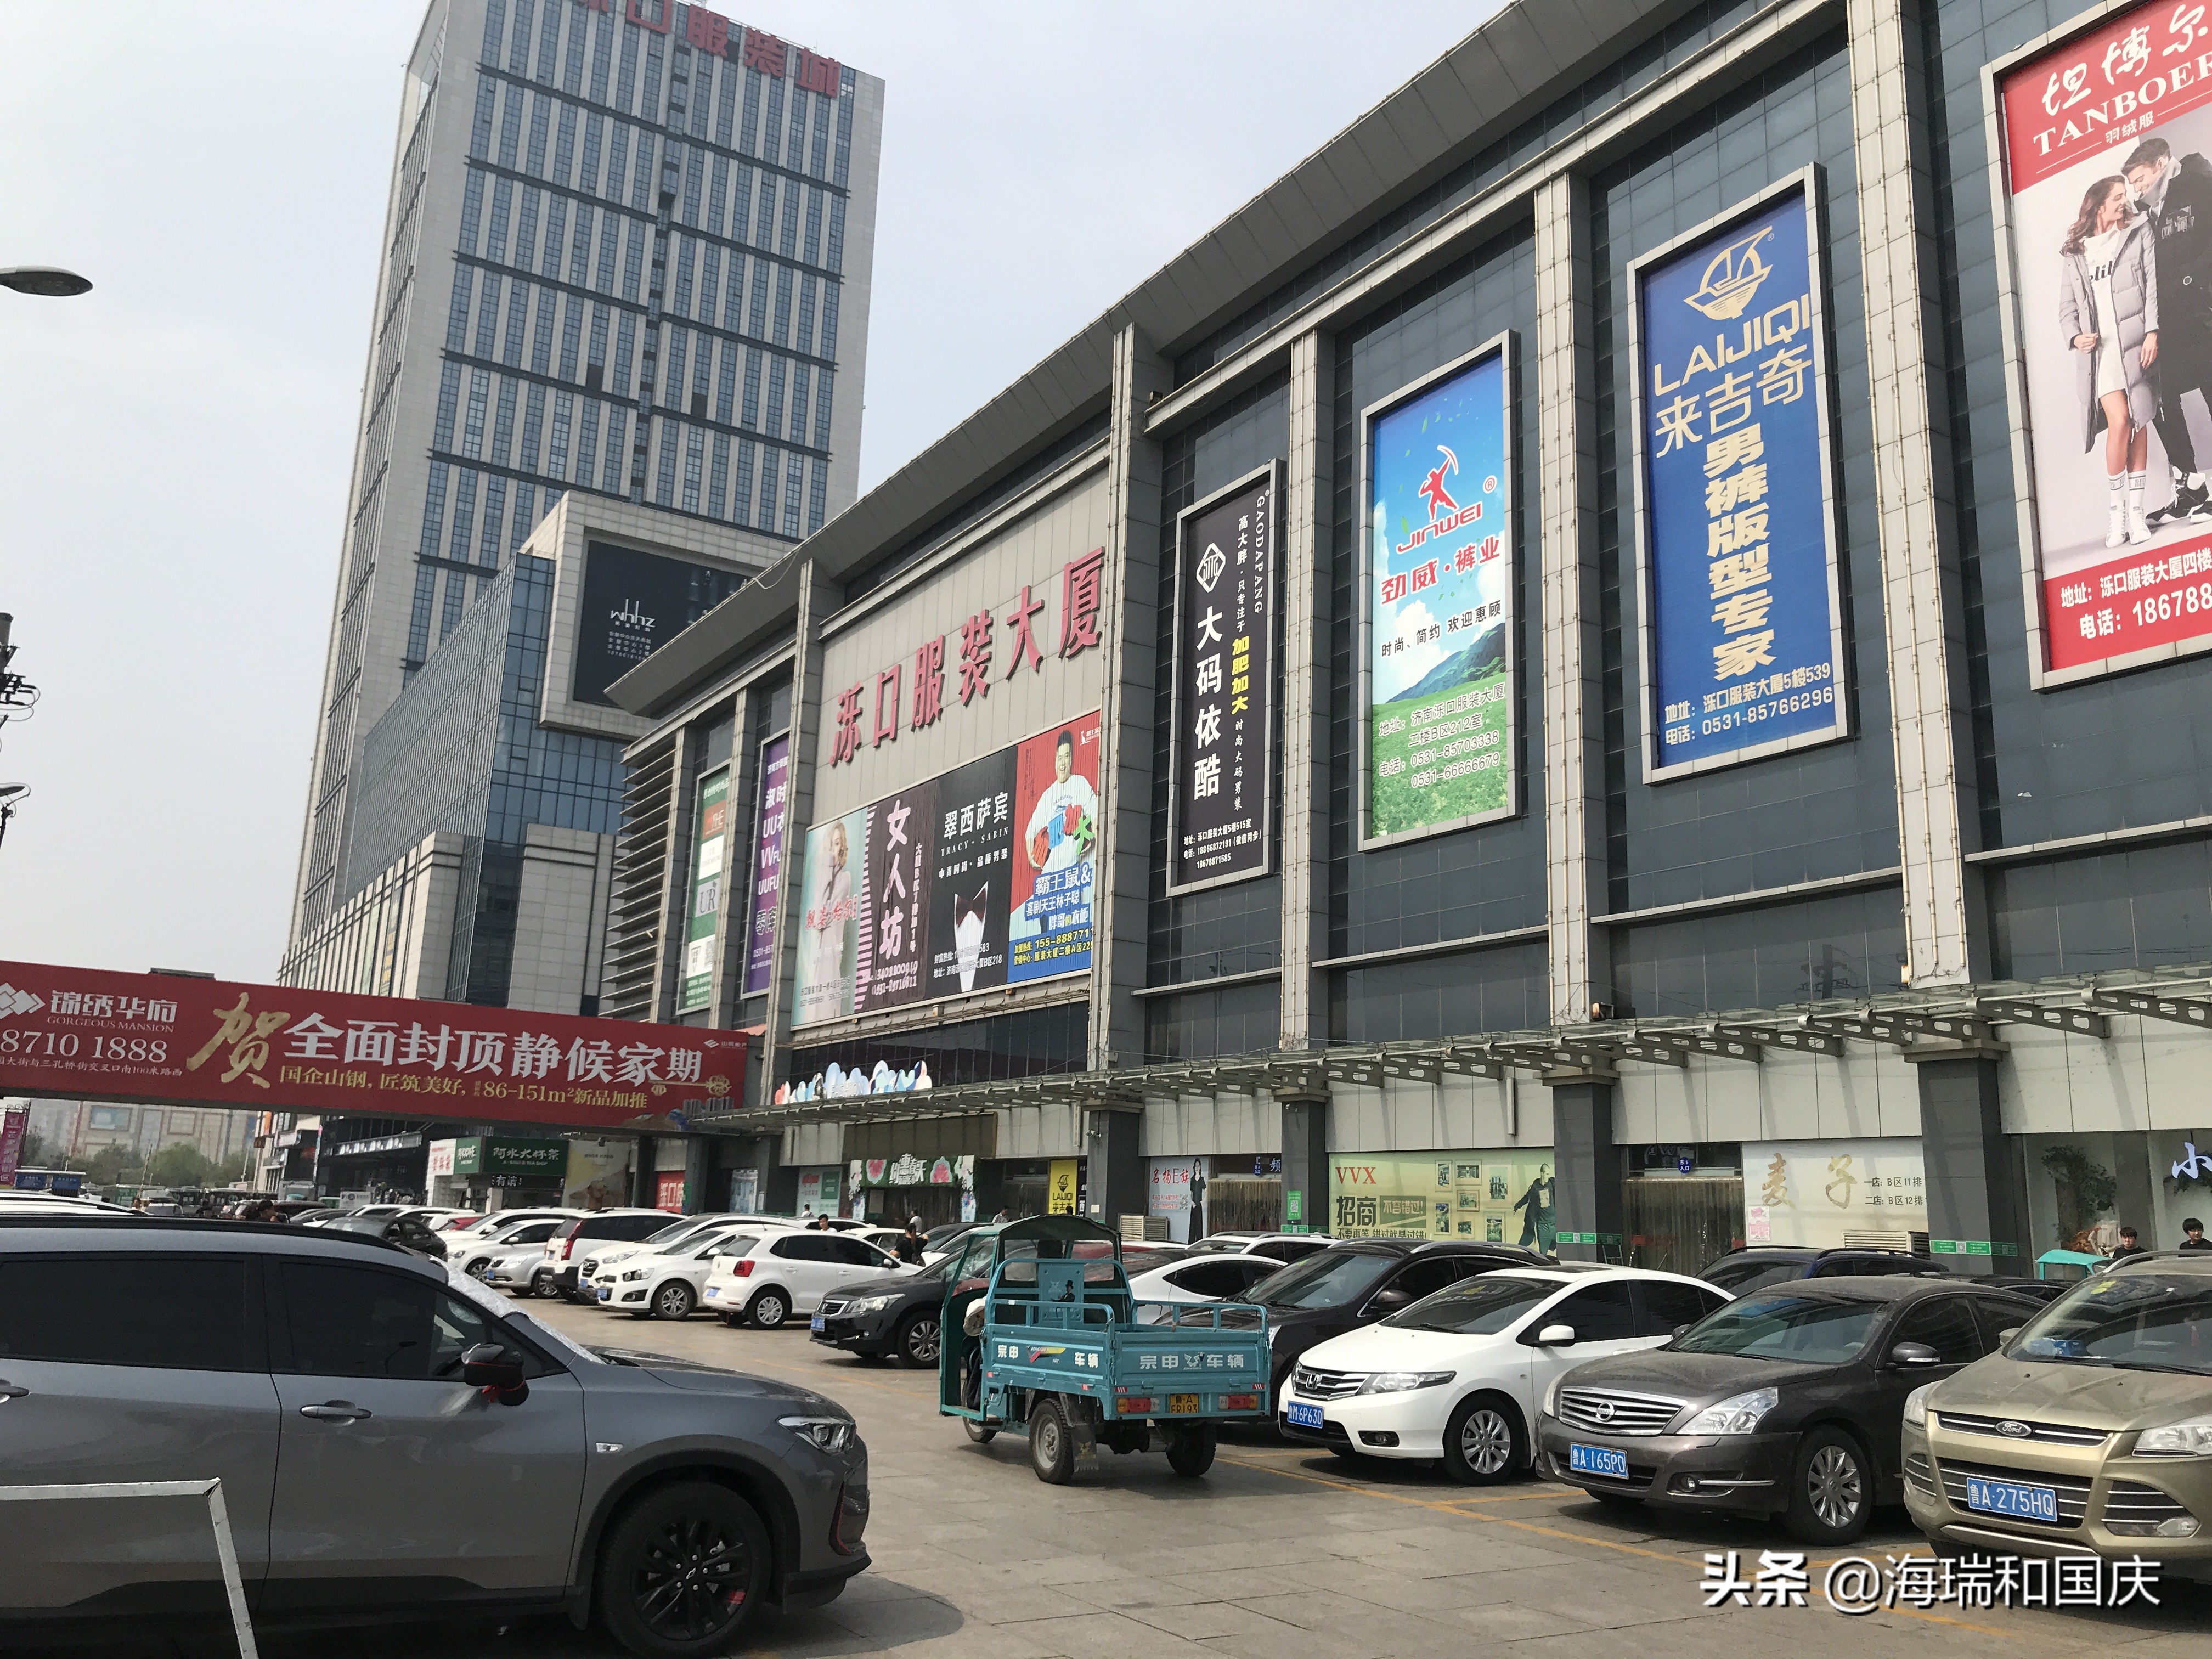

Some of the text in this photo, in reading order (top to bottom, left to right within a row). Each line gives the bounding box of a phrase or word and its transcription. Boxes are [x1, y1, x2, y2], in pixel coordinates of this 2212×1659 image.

[589, 0, 841, 98] 口服装城
[2106, 111, 2154, 144] 羽绒服
[1655, 294, 1810, 396] LAIJIQI
[1656, 345, 1812, 458] 来吉奇
[1397, 503, 1482, 554] JINWEI
[1703, 423, 1777, 681] 男裤版型专家
[1254, 495, 1265, 613] GAODAPANG
[1381, 537, 1500, 605] 劲威·裤业
[1381, 600, 1502, 657] 时尚、简约 欢迎惠顾
[830, 546, 1104, 766] 泺口服装大厦
[1231, 635, 1250, 715] 加肥加大
[1194, 606, 1223, 800] 大码依酷
[1411, 683, 1505, 727] 济南泺口服装大厦
[1702, 687, 1833, 735] 0531-85766296
[1703, 662, 1830, 714] 泺口服装大厦5楼539
[1408, 714, 1483, 748] 二楼B区212室
[1410, 731, 1499, 766] 0531-85703338
[1233, 719, 1244, 811] 时尚大码男装
[1411, 753, 1499, 788] 0531-66666679
[944, 792, 1008, 840] 翠西萨宾
[981, 826, 1009, 844] SABIN
[879, 799, 911, 960] 女人坊
[1026, 889, 1080, 916] 喜剧天王林子聪
[0, 1029, 167, 1063] 8710 1888
[47, 1015, 174, 1033] GORGEOUS MANSION
[186, 992, 291, 1088] 贺
[283, 1012, 703, 1087] 全面封顶静候家期
[494, 1147, 560, 1160] 阿水大杯茶
[1335, 1166, 1376, 1184] VVX
[2172, 1142, 2212, 1179] 小
[1336, 1196, 1377, 1227] 招商
[998, 1345, 1098, 1368] 宗申 车辆
[1140, 1354, 1244, 1369] 宗申 车辆
[2002, 1422, 2022, 1434] Ford
